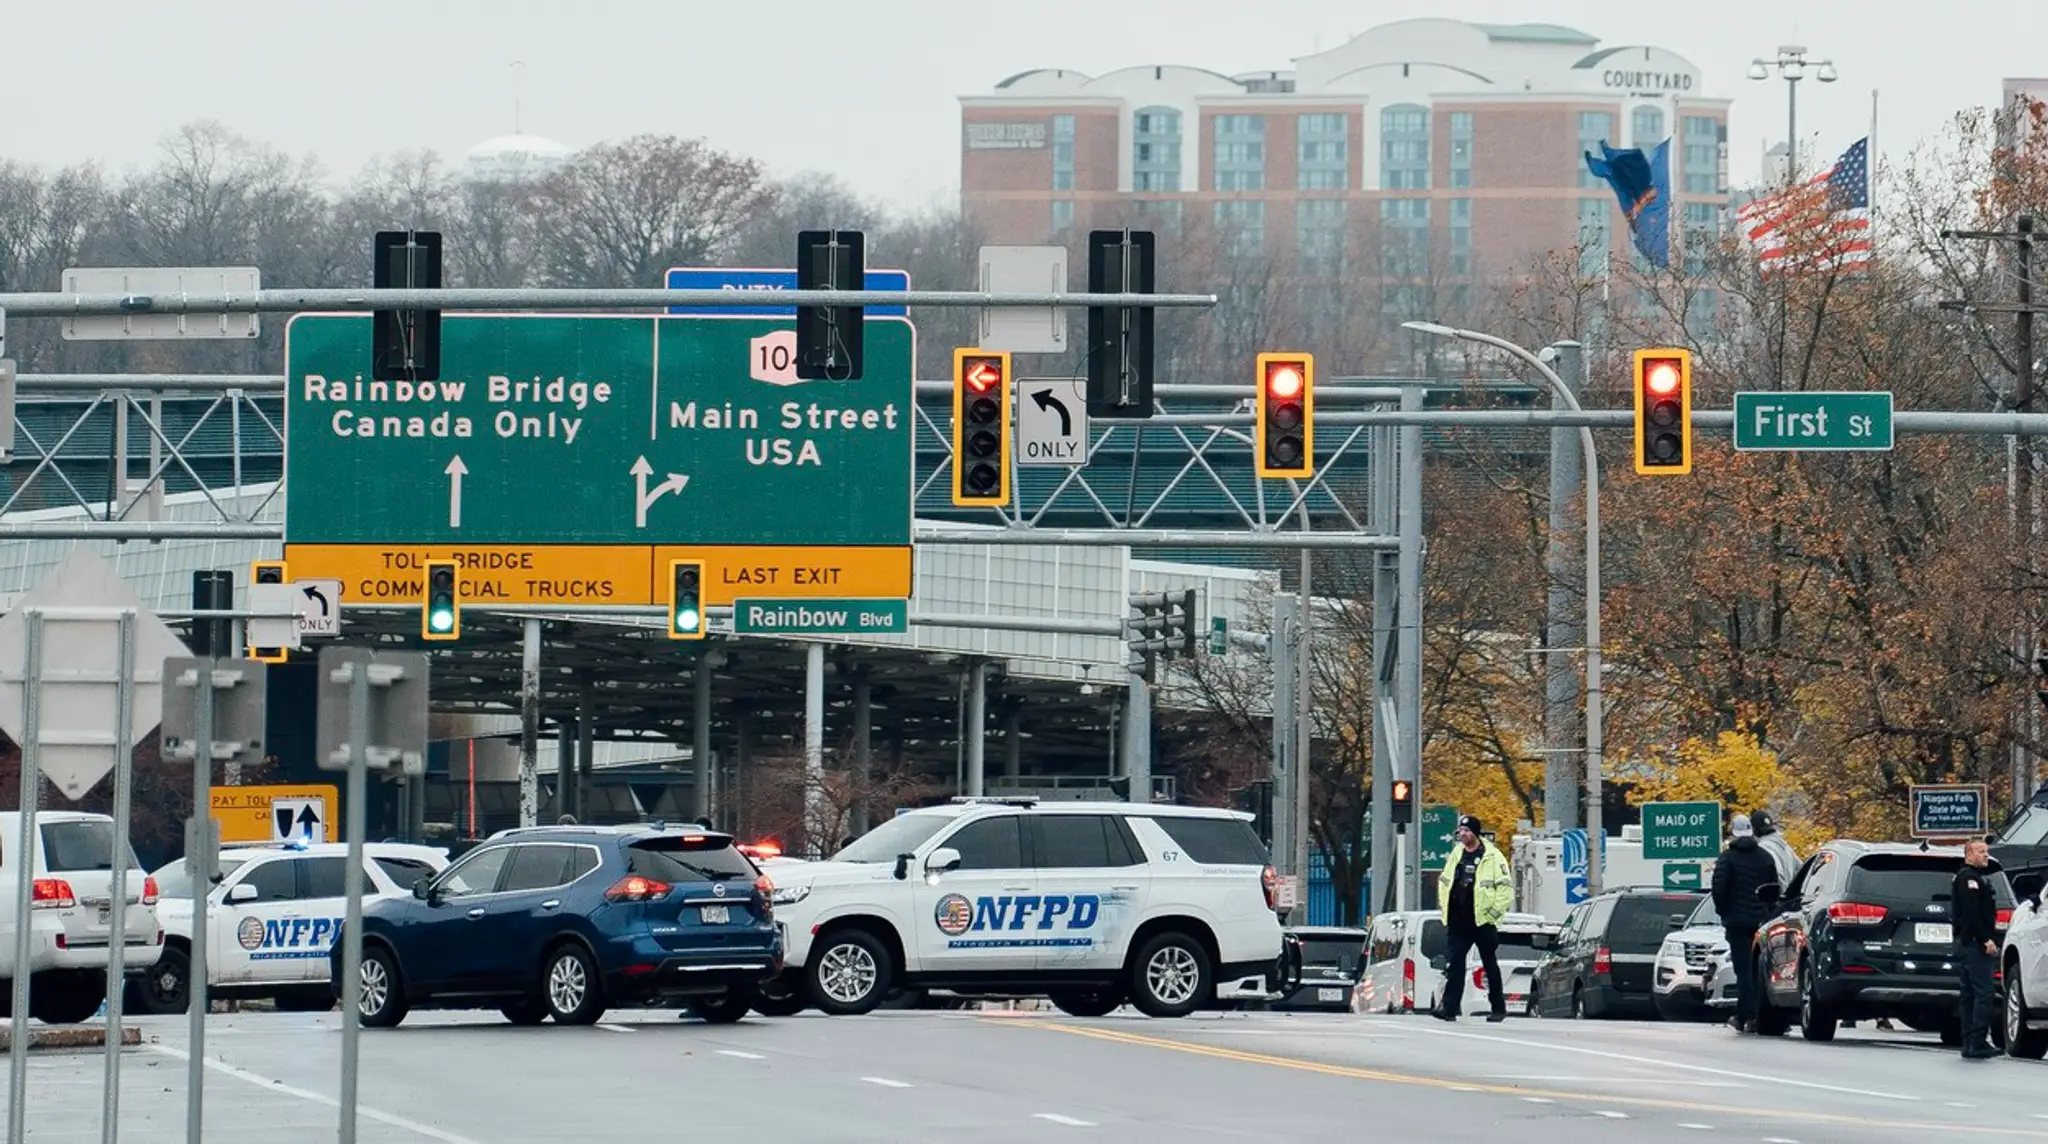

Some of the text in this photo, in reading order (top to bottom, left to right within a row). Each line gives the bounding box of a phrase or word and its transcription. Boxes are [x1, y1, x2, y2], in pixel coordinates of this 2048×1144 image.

[1604, 70, 1692, 90] COURTYARD
[760, 345, 797, 372] 10
[304, 375, 612, 411] Rainbow Bridge
[670, 402, 898, 429] Main Street
[1755, 405, 1873, 437] First St
[332, 409, 583, 444] Canada Only
[746, 439, 822, 465] USA
[1027, 441, 1078, 458] ONLY
[452, 553, 533, 569] BRIDGE
[724, 567, 841, 584] LAST EXIT
[360, 580, 511, 597] COMMCIAL
[525, 580, 614, 597] TRUCKS
[299, 619, 332, 630] ONLY
[749, 606, 893, 627] Rainbow Blvd
[212, 795, 237, 806] PAY
[1949, 804, 1969, 813] Park
[1655, 814, 1707, 826] MAID OF
[1654, 836, 1709, 848] THE MIST
[1162, 851, 1178, 862] 67
[970, 894, 1099, 932] NFPD
